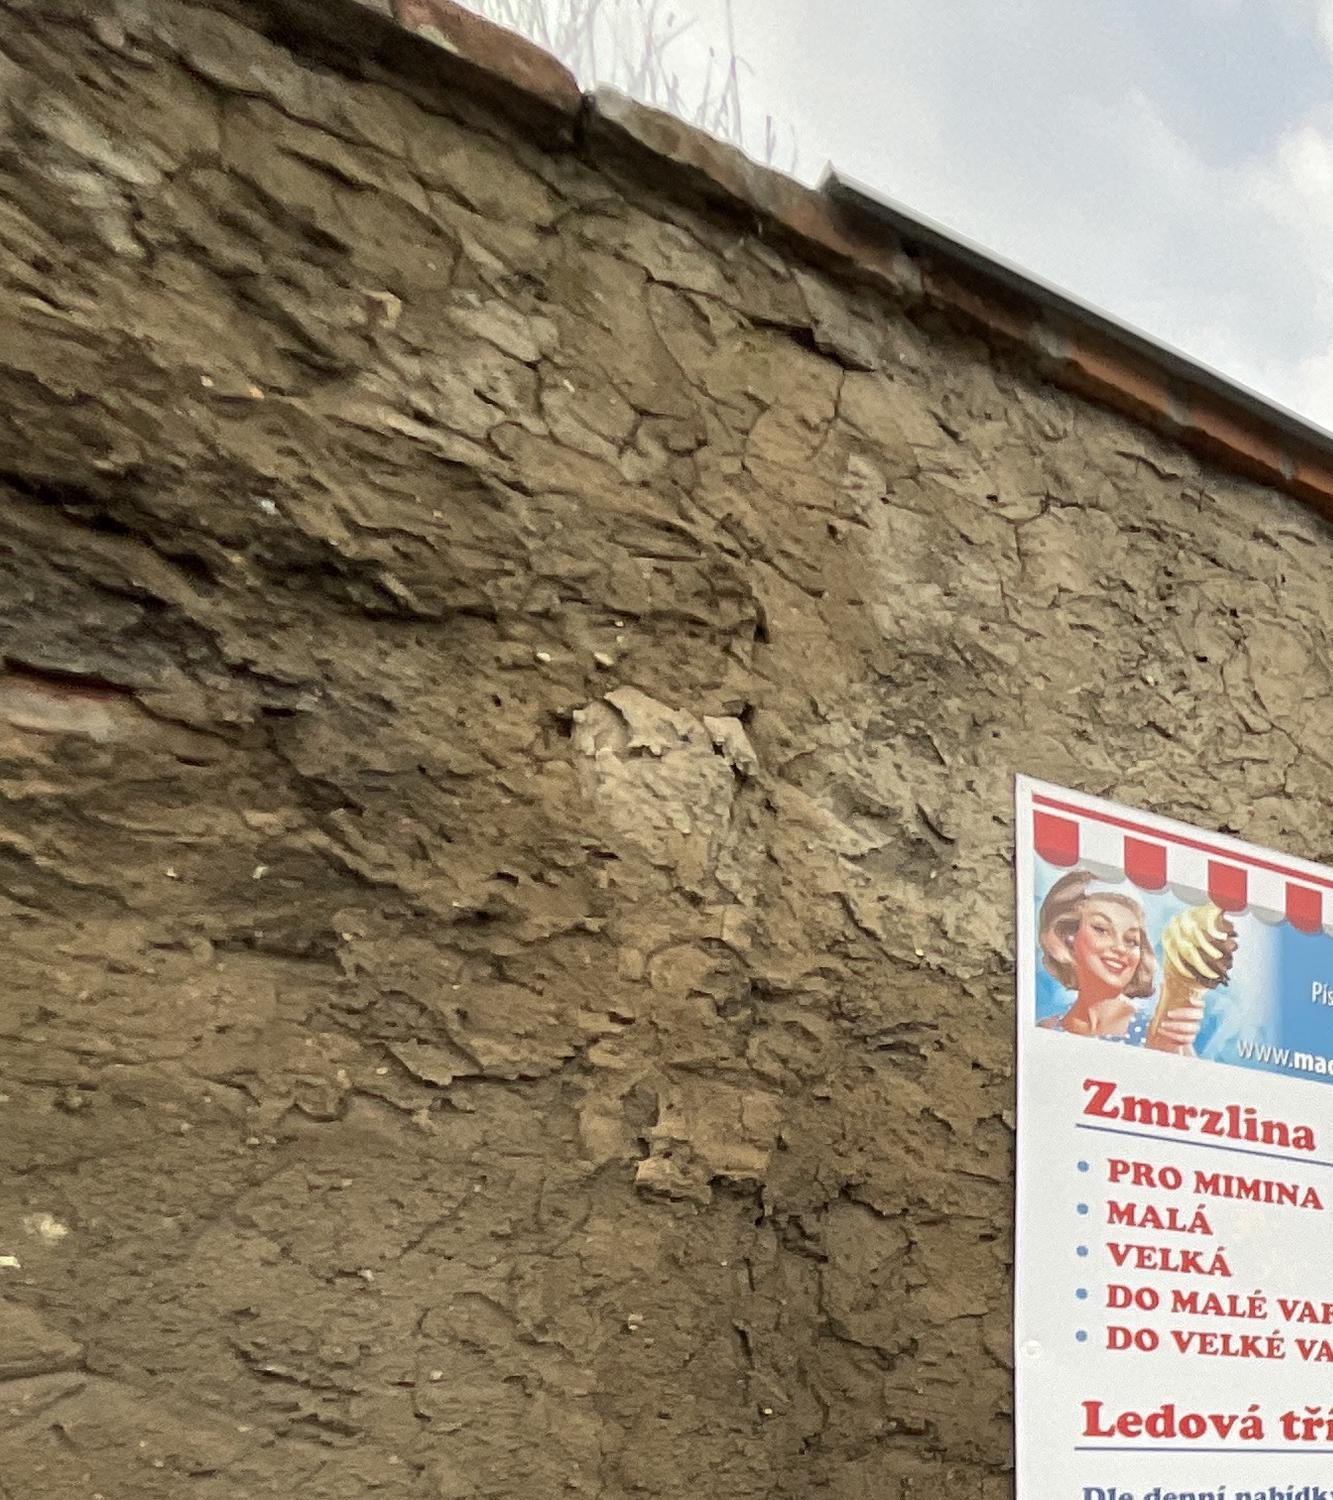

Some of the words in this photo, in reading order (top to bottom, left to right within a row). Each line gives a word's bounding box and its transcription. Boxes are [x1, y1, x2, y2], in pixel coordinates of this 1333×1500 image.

[1082, 1078, 1316, 1152] Zmrzlina
[1107, 1158, 1182, 1190] PRO
[1194, 1170, 1324, 1210] MIMINA
[1107, 1200, 1213, 1236] MALÁ
[1107, 1242, 1233, 1277] VELKÁ
[1106, 1284, 1159, 1311] DO
[1171, 1289, 1268, 1319] MALÉ
[1106, 1326, 1159, 1352] DO
[1171, 1329, 1286, 1359] VELKÉ
[1081, 1400, 1265, 1441] Ledová
